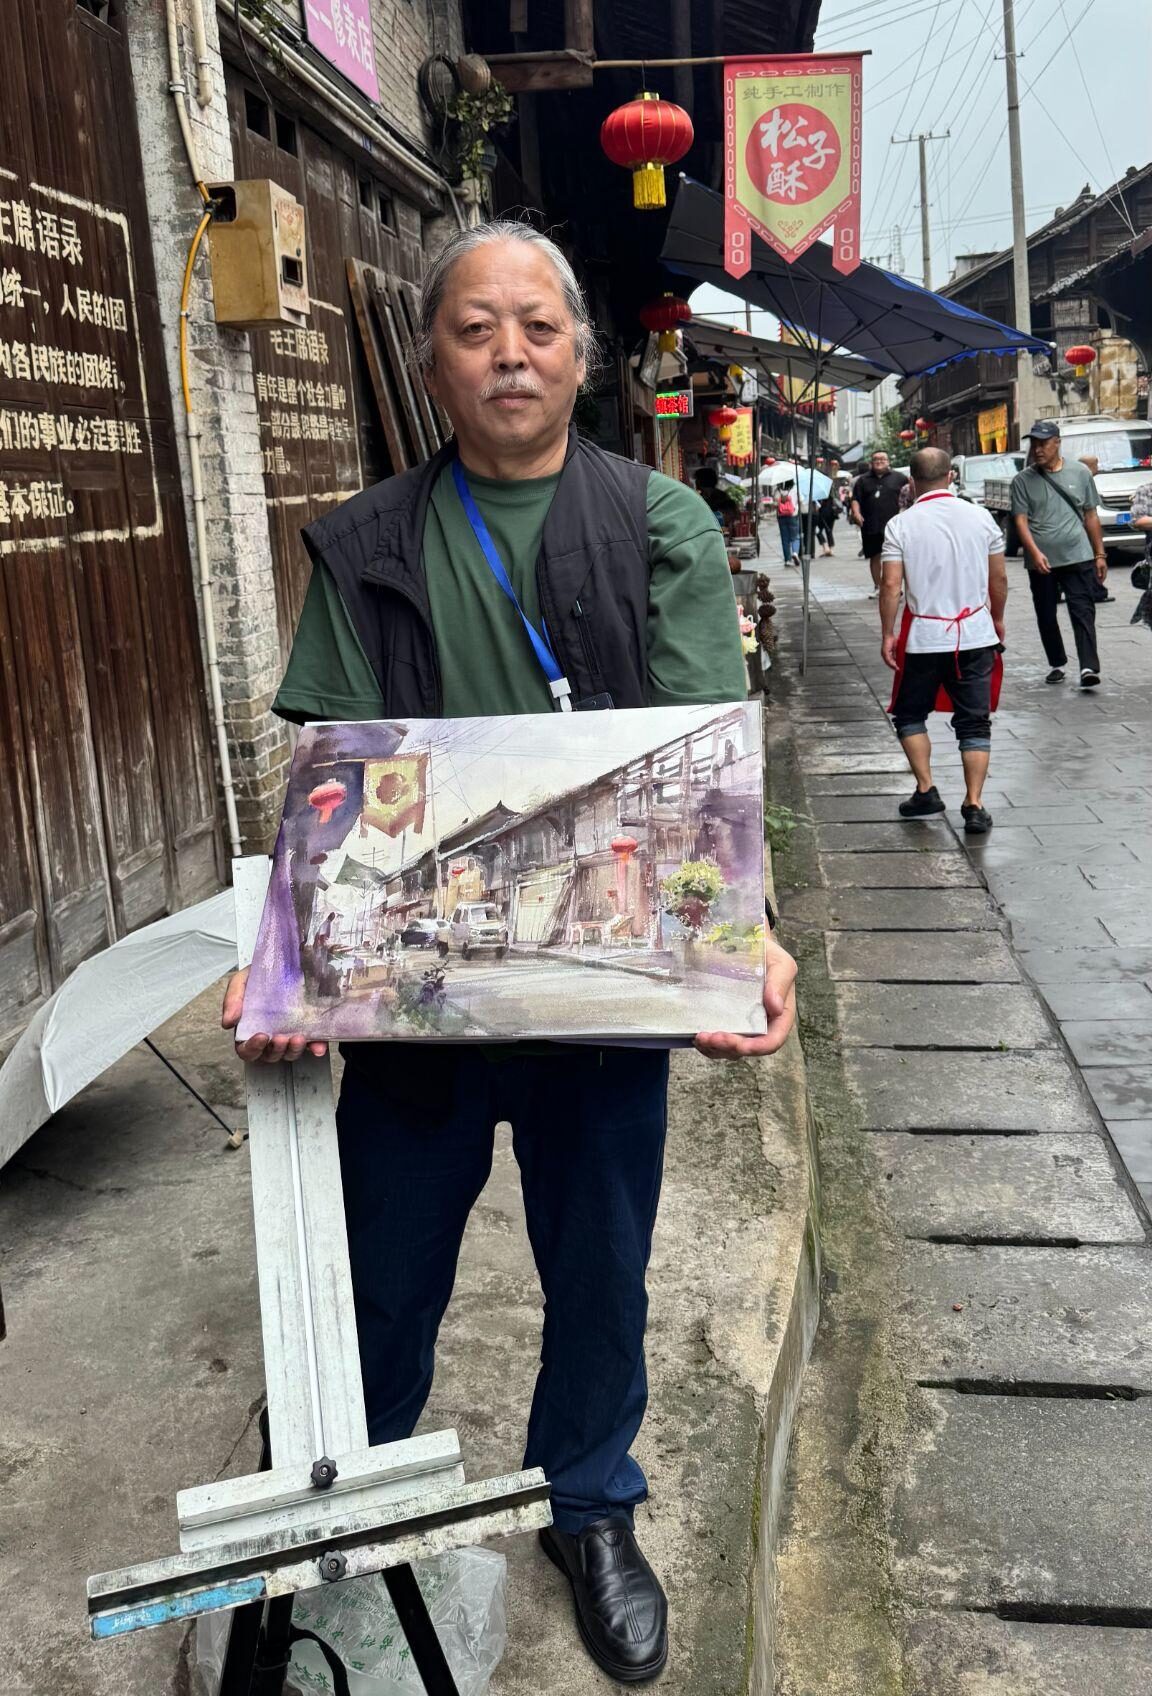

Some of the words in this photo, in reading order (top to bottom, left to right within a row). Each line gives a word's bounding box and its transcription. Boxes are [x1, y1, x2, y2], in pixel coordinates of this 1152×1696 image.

[743, 83, 845, 99] 纯手工制作
[760, 108, 836, 170] 松子
[766, 160, 809, 200] 酥
[0, 266, 128, 333] 统一，人民的团
[269, 328, 329, 364] 毛主席语录
